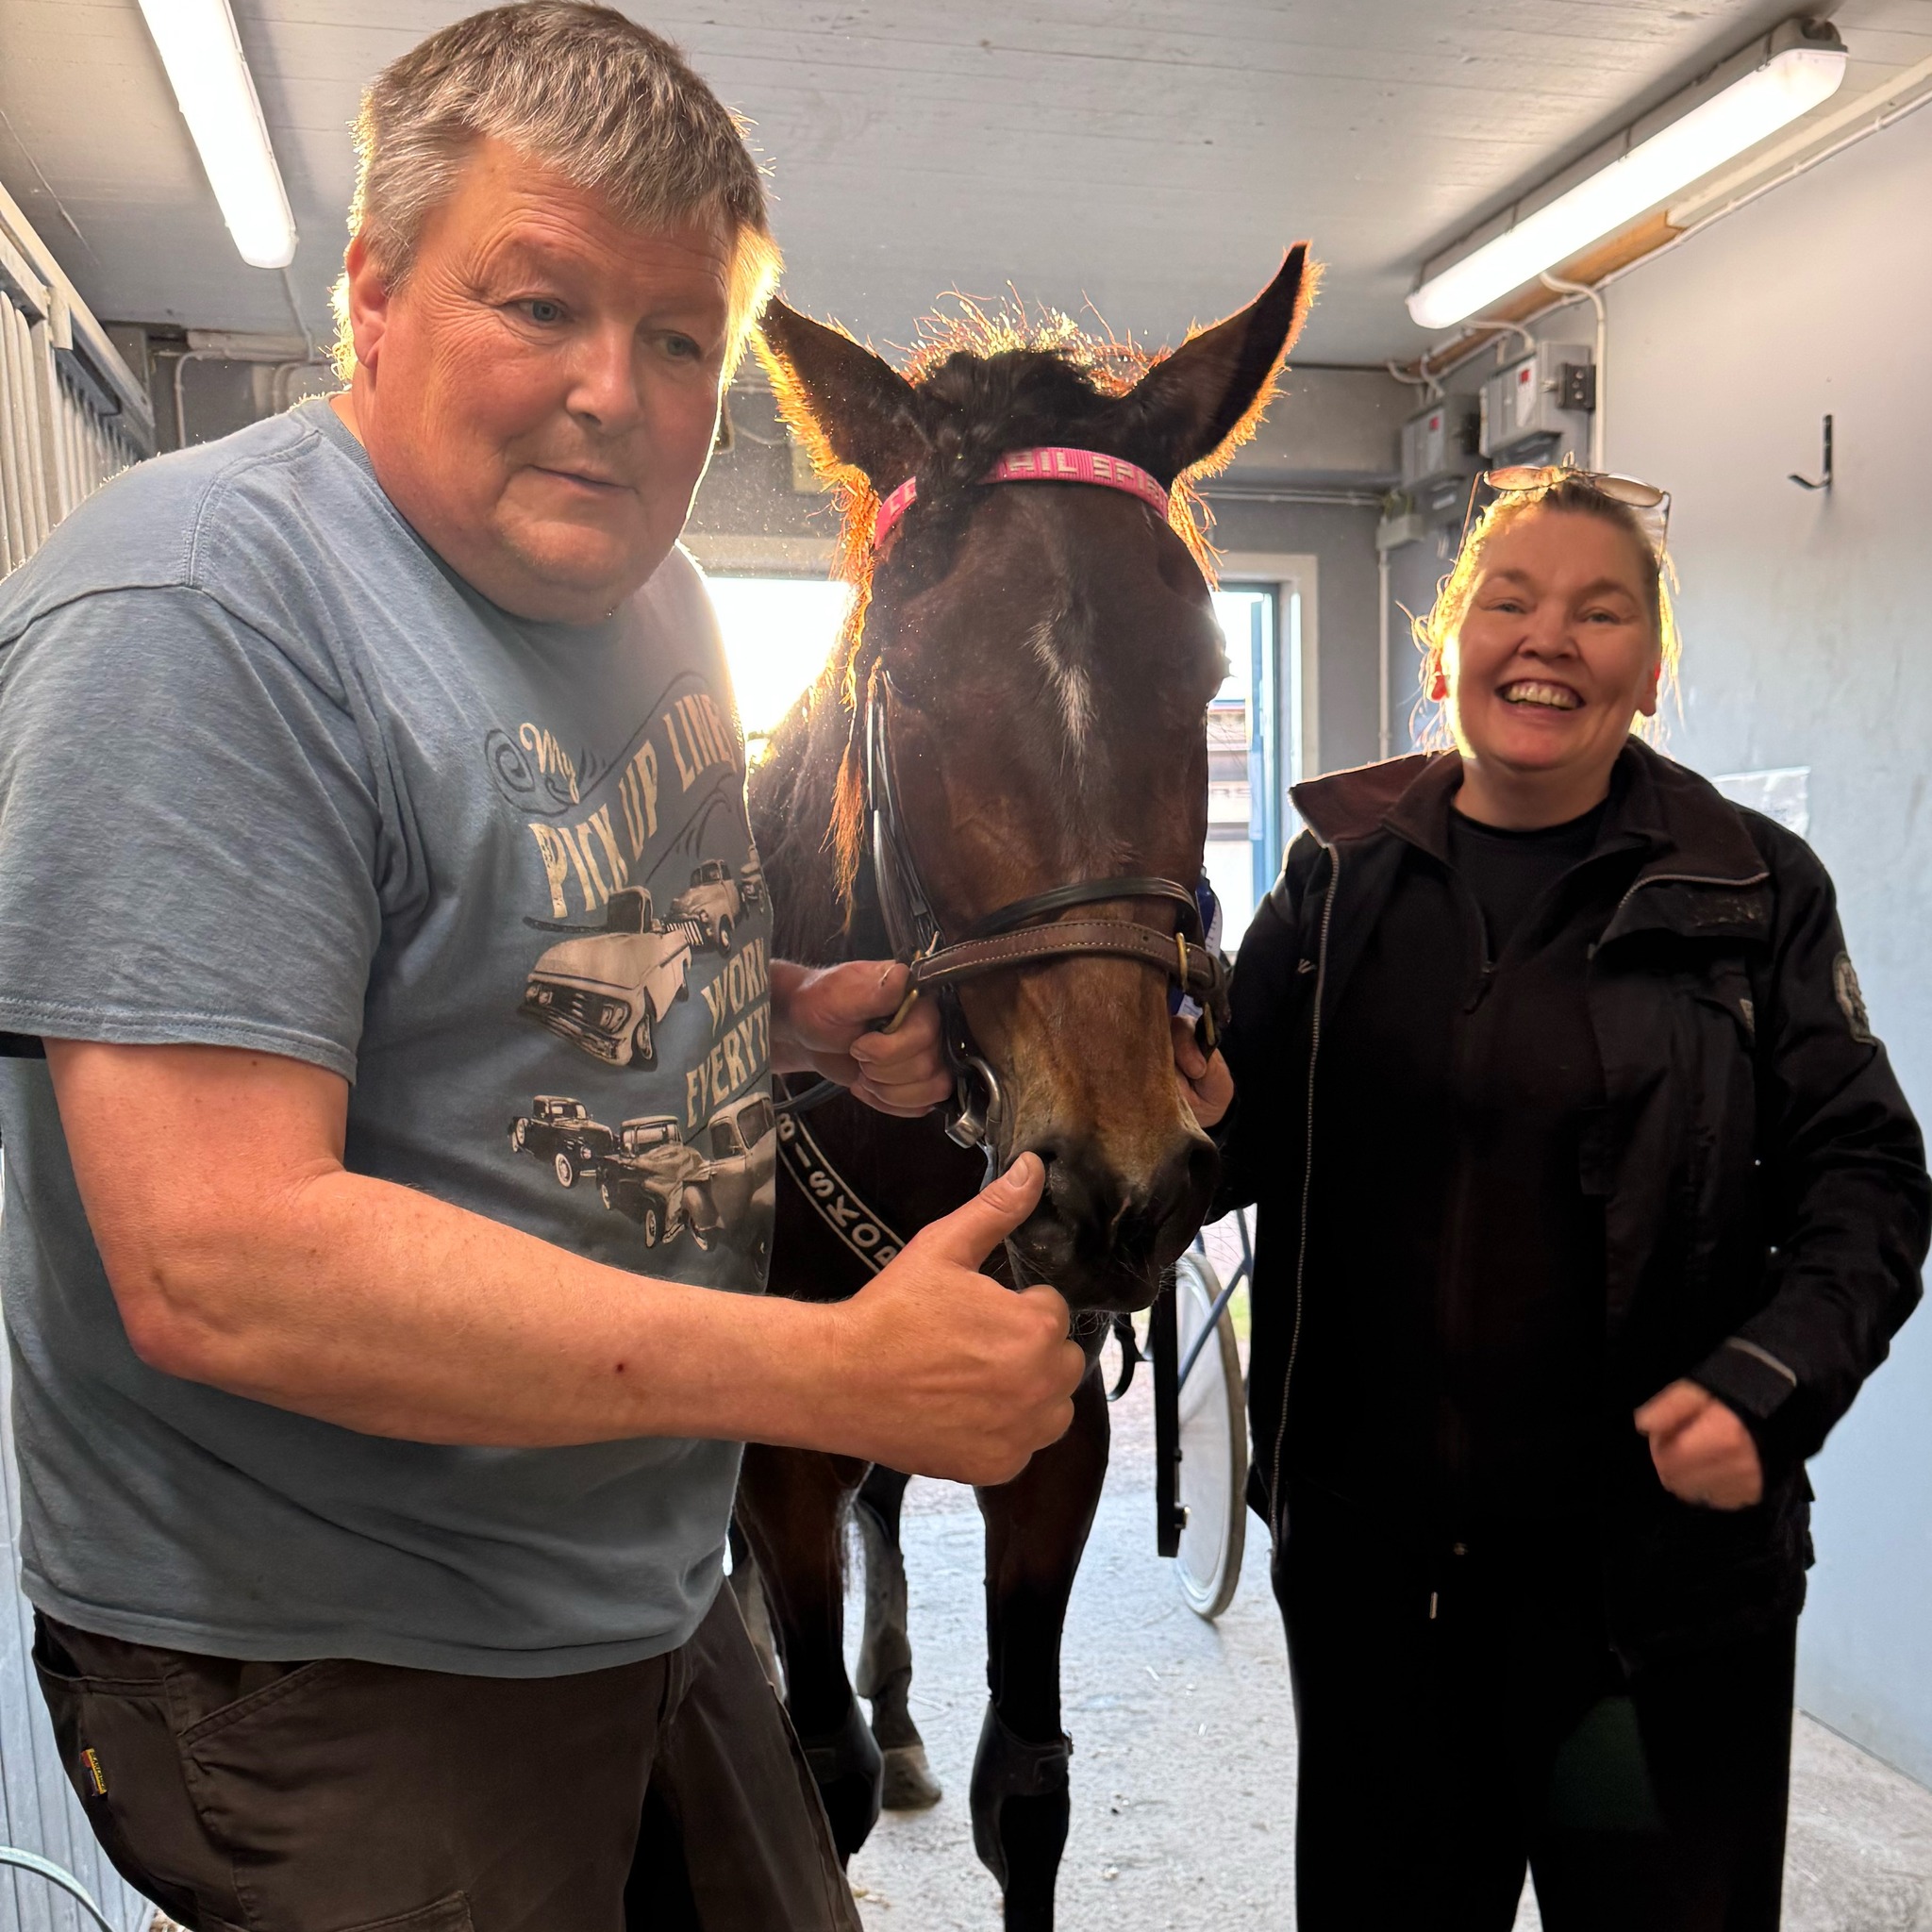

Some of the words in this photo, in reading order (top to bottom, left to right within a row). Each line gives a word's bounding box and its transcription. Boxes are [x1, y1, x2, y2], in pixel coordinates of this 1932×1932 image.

[519, 721, 580, 805] My
[527, 803, 629, 919] PICK
[618, 739, 658, 863] UP
[686, 1000, 772, 1128] EVERYTI
